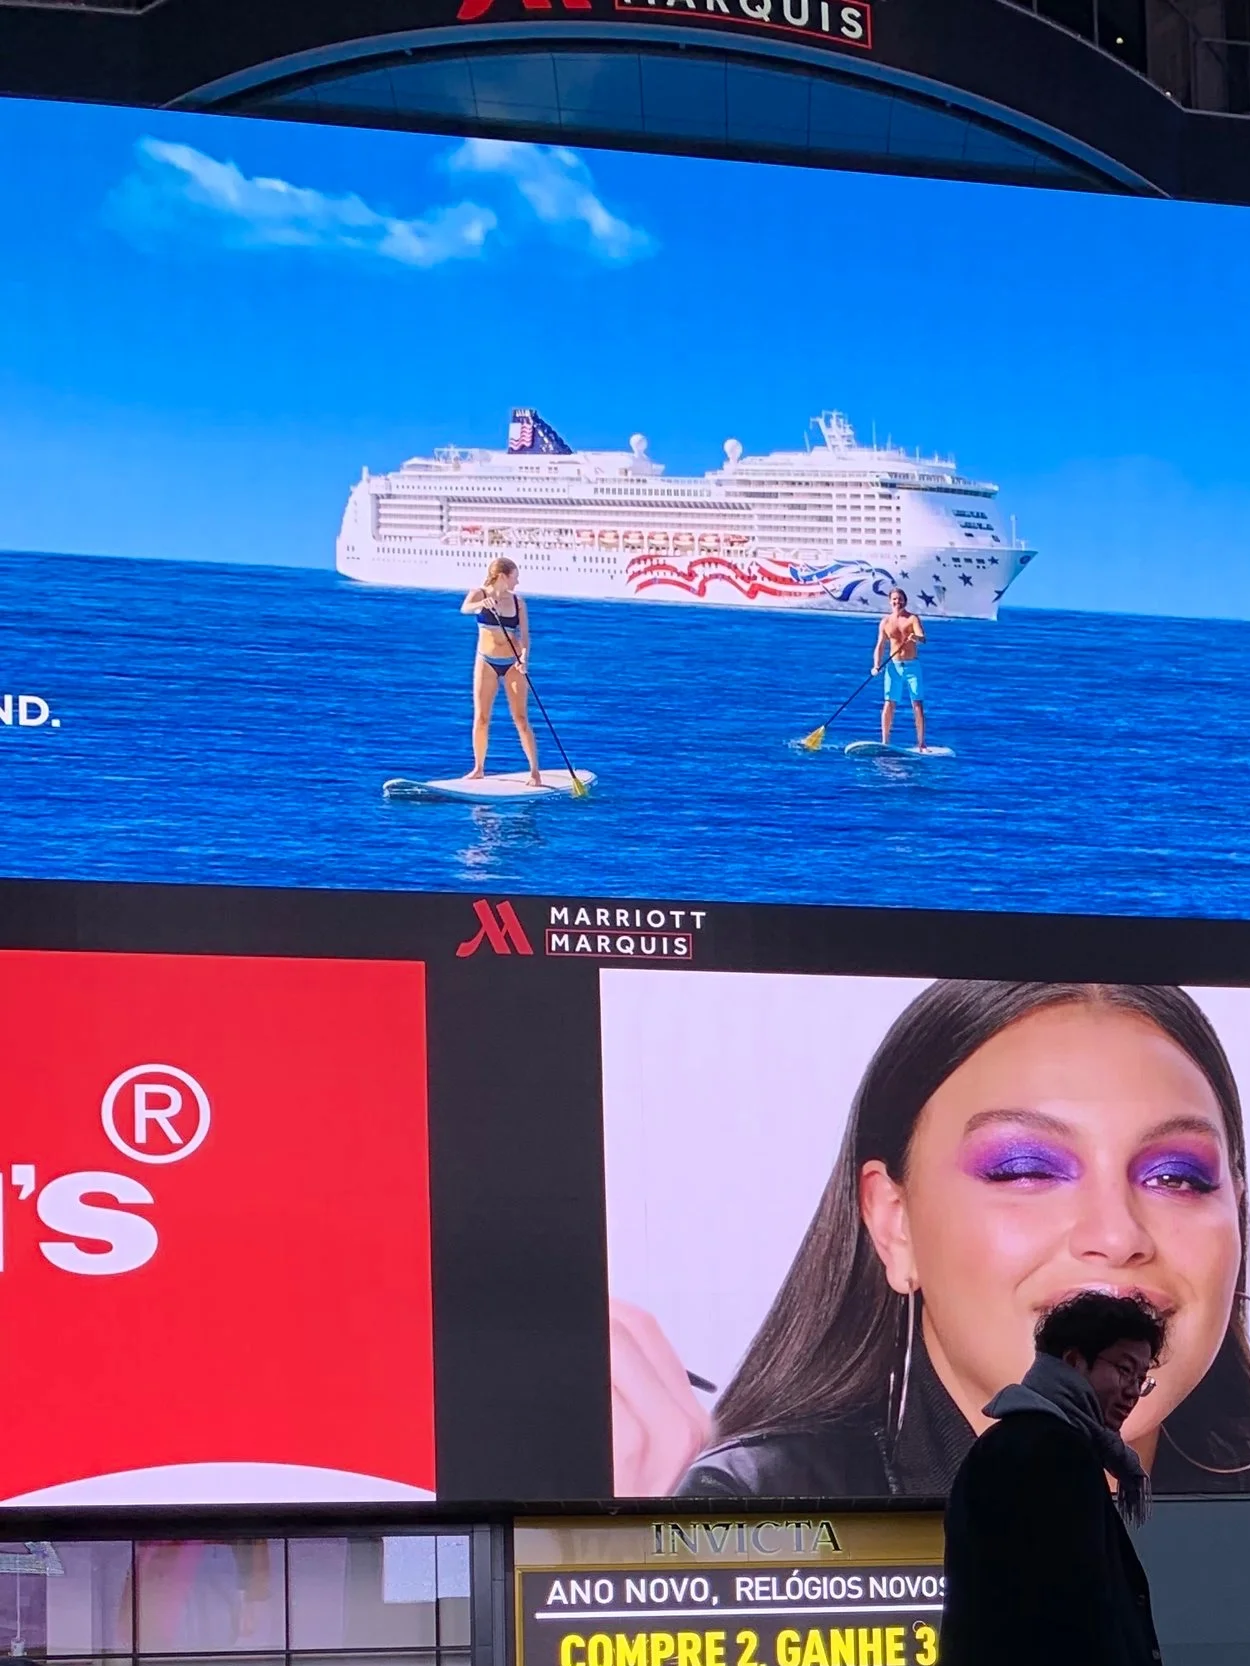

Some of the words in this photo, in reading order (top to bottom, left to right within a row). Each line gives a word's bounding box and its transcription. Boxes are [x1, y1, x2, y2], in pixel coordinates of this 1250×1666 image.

[550, 906, 706, 929] MARRIOTT
[551, 933, 689, 956] MARQUIS
[651, 1520, 843, 1556] INVICTA
[546, 1579, 613, 1605] ANO
[626, 1577, 719, 1606] NOVO,
[736, 1569, 863, 1601] RELÓGIOS
[915, 1626, 938, 1666] 3
